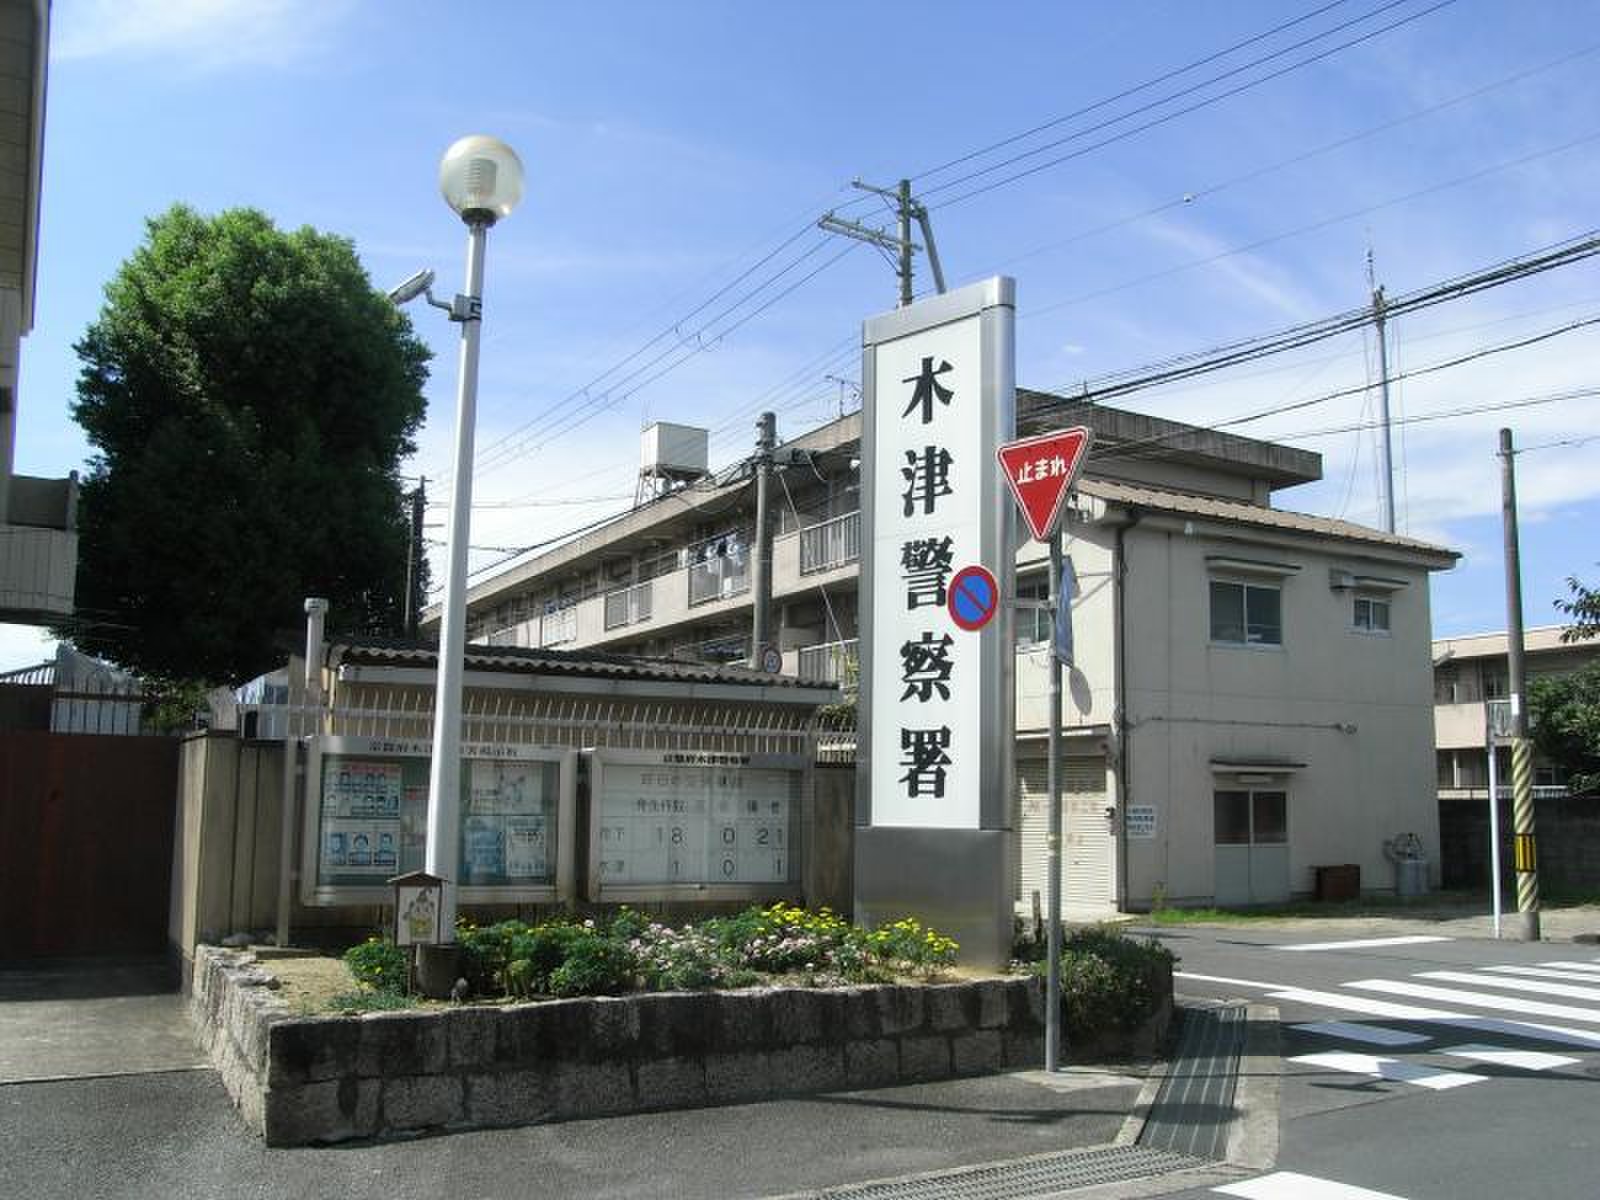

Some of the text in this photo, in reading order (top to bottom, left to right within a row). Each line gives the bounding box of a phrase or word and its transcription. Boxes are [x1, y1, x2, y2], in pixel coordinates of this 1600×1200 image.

[1017, 454, 1068, 485] 止まれ
[898, 356, 955, 799] 木津警察署
[722, 826, 736, 845] 0
